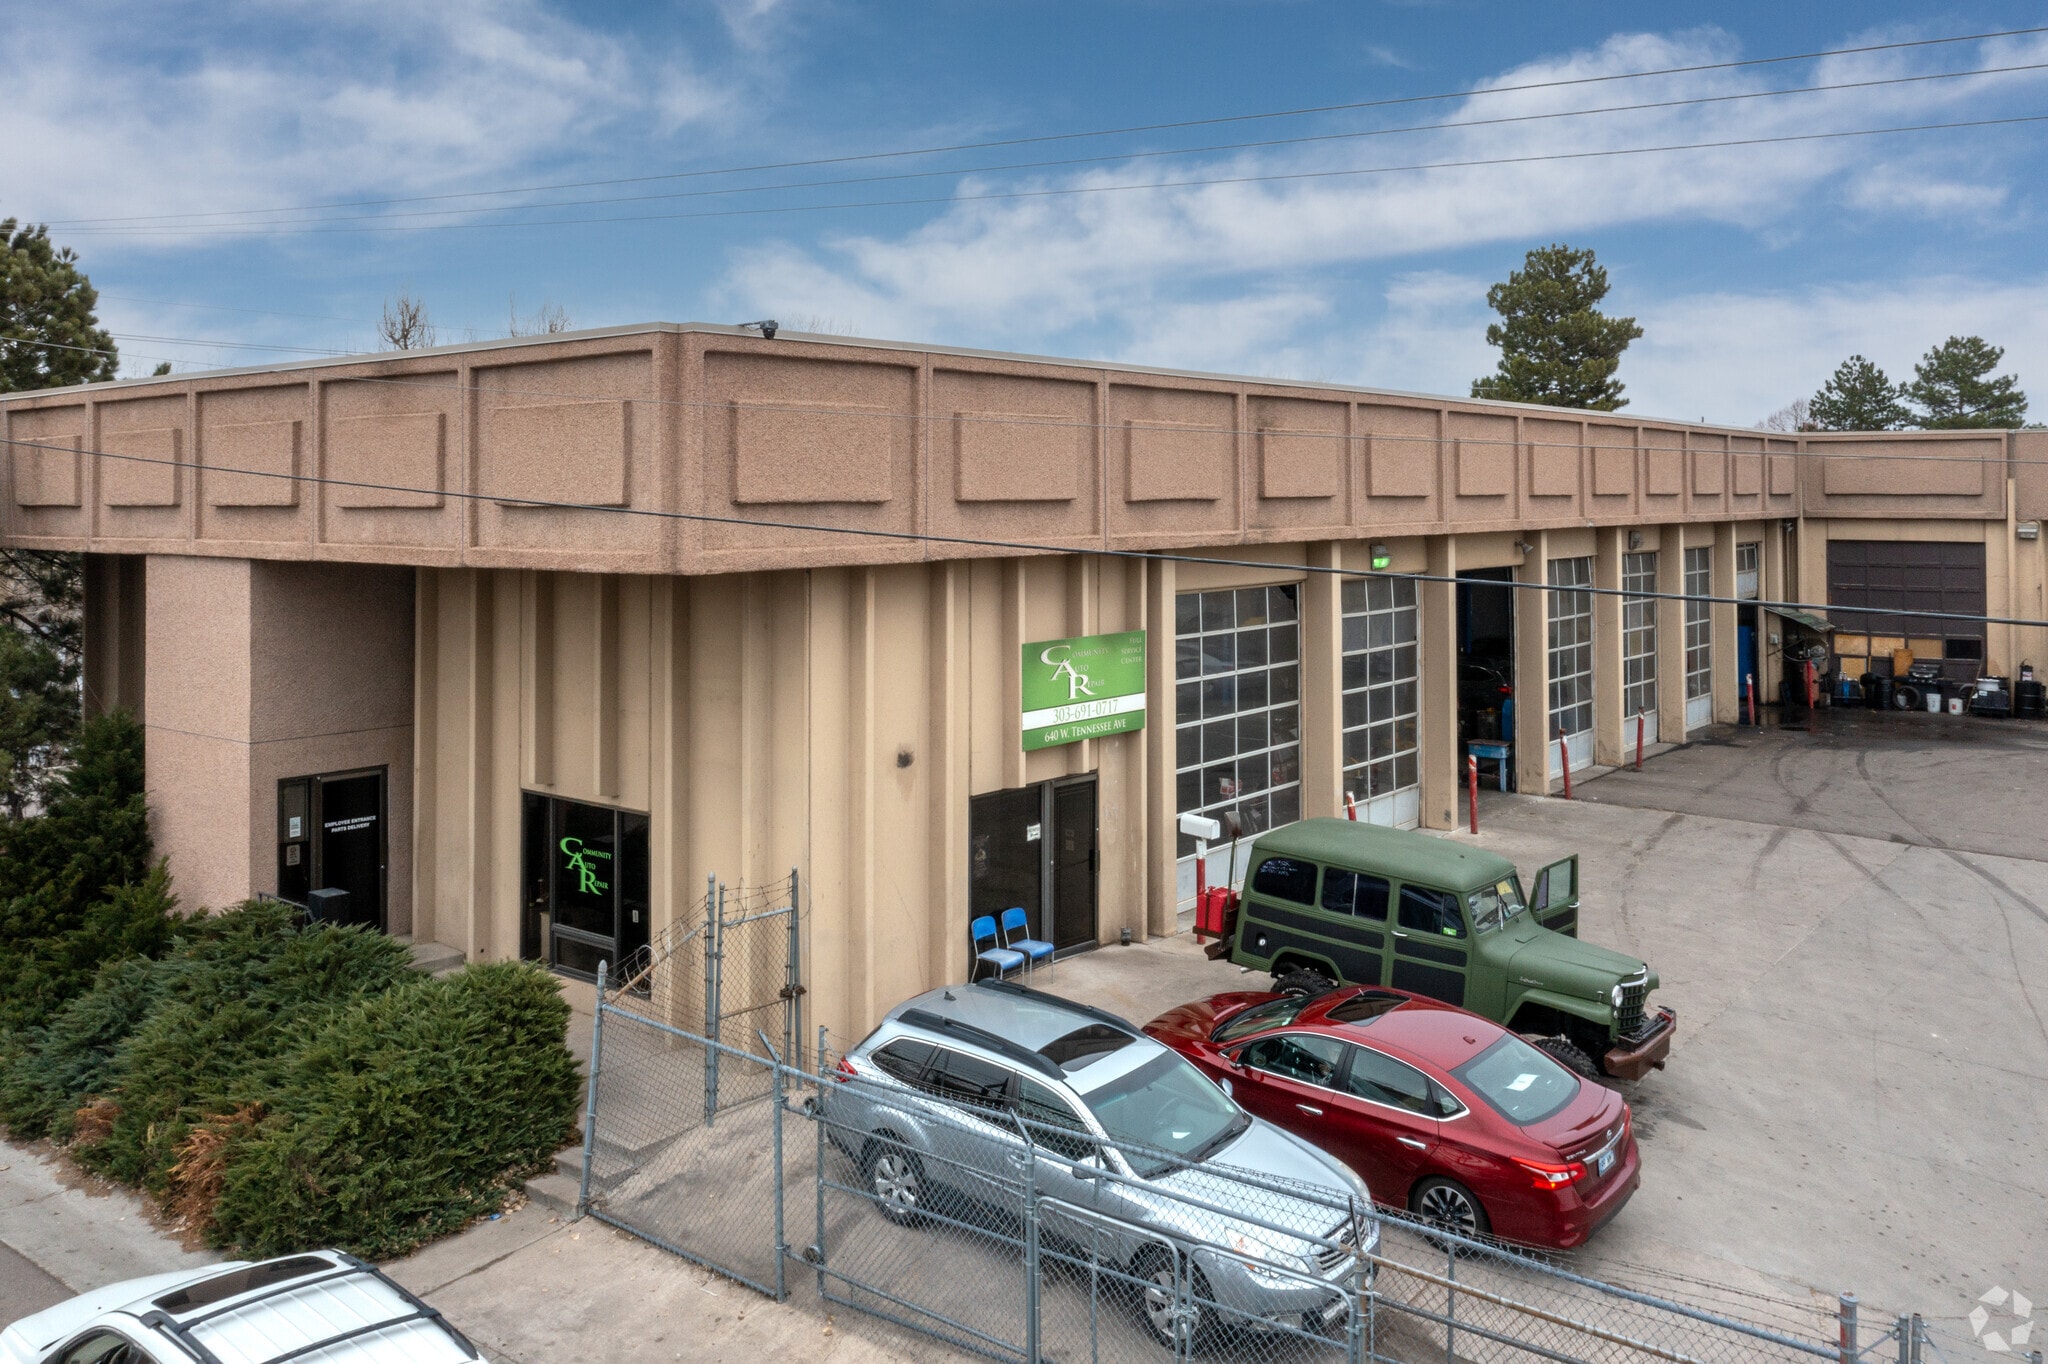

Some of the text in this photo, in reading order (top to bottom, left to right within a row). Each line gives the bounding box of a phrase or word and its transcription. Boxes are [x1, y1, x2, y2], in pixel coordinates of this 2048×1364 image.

[1121, 656, 1142, 665] CENTER
[1053, 700, 1118, 723] 303-691-0717
[1044, 719, 1126, 742] 640 W. TENNESSEE AVE
[325, 819, 350, 828] EMPLOYEE
[348, 822, 370, 830] DELIVERY
